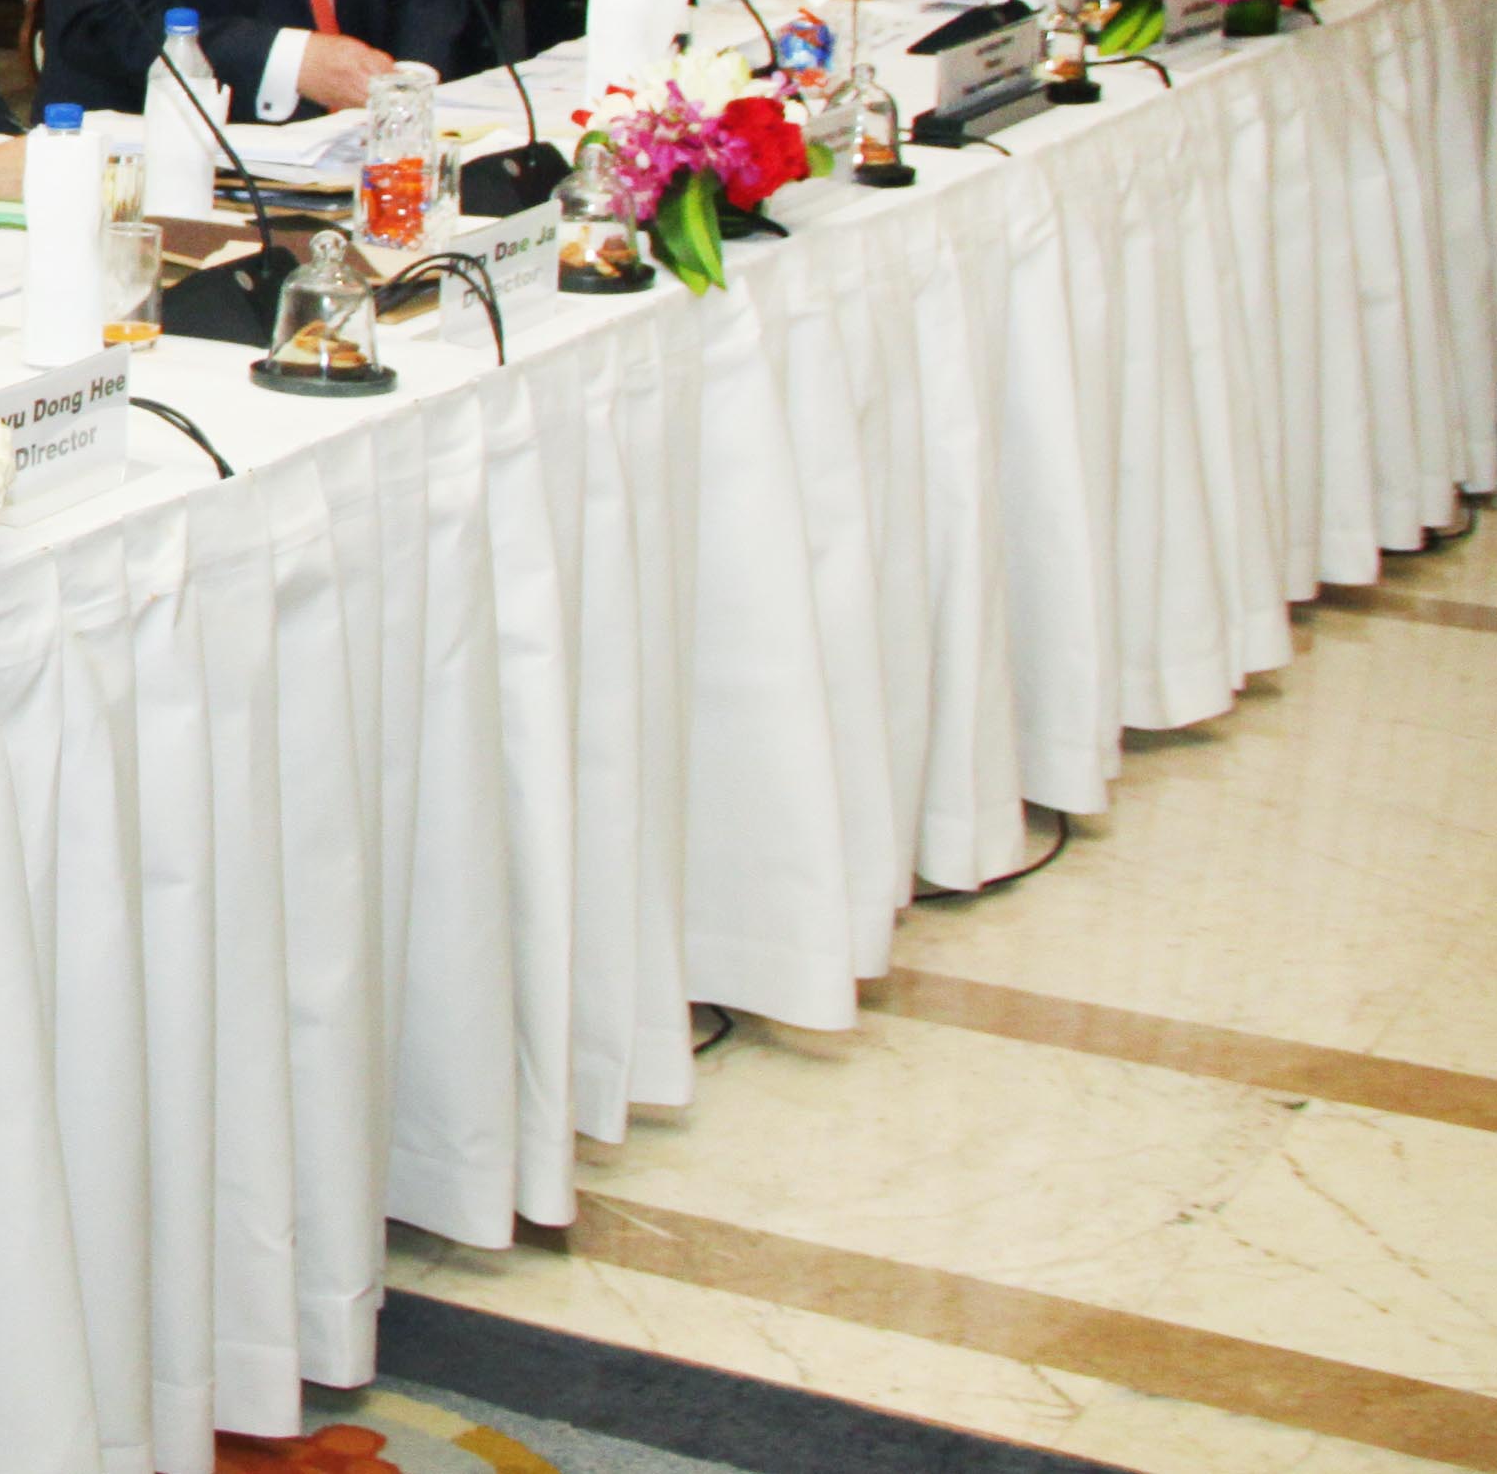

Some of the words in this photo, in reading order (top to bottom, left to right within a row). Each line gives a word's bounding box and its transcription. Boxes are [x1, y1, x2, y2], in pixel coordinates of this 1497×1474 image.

[33, 390, 83, 422] Dong
[89, 374, 126, 402] Hee
[14, 426, 97, 471] Director
